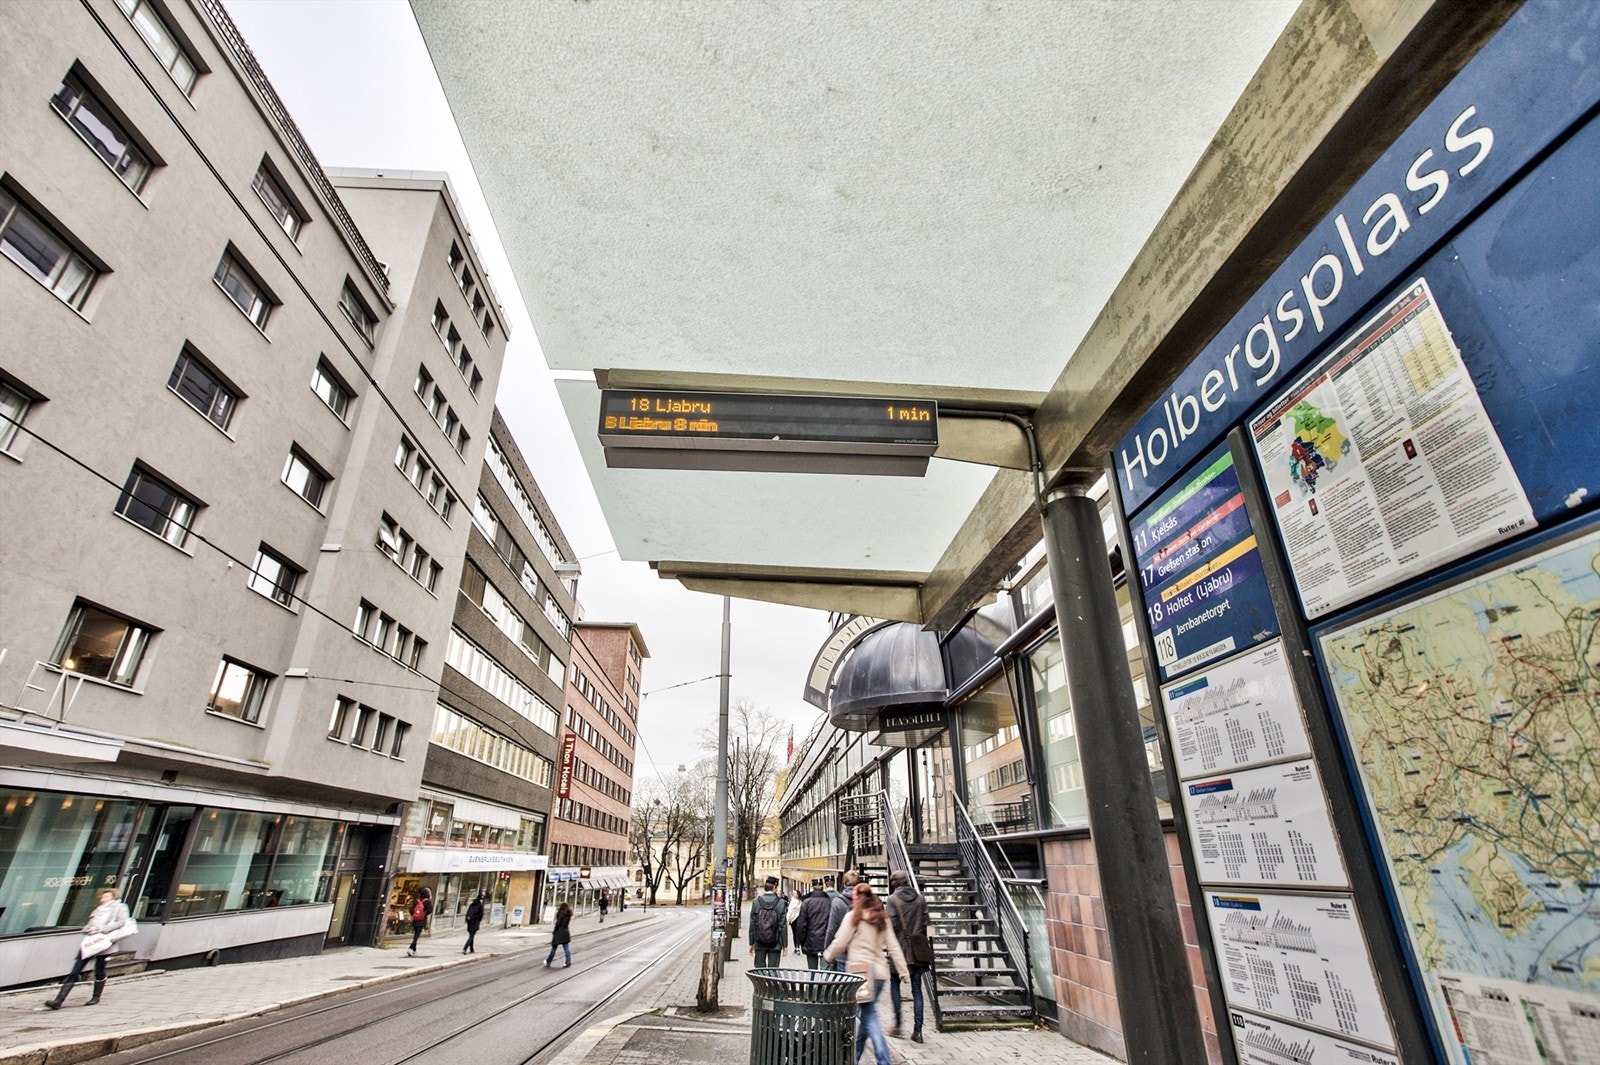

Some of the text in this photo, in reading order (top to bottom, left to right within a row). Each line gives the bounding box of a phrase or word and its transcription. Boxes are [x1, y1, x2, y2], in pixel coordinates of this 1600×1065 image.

[1121, 105, 1495, 492] Holbergsplass
[630, 398, 930, 421] 18 Ljabru 1 min
[674, 418, 687, 431] 8
[1134, 530, 1147, 551] 11
[1151, 516, 1178, 542] Kjelsås
[1497, 522, 1518, 535] Ruter
[1141, 564, 1153, 587] 17
[1158, 554, 1184, 577] Grefsen
[1185, 536, 1212, 559] stason
[1148, 602, 1163, 625] 18
[1166, 592, 1194, 616] Holtet
[1196, 568, 1233, 600] (Ljabru)
[818, 616, 875, 672] BRASSERI
[1158, 636, 1174, 661] 118
[1176, 599, 1231, 636] Jernbanetorget
[560, 743, 574, 794] Thon Hotels
